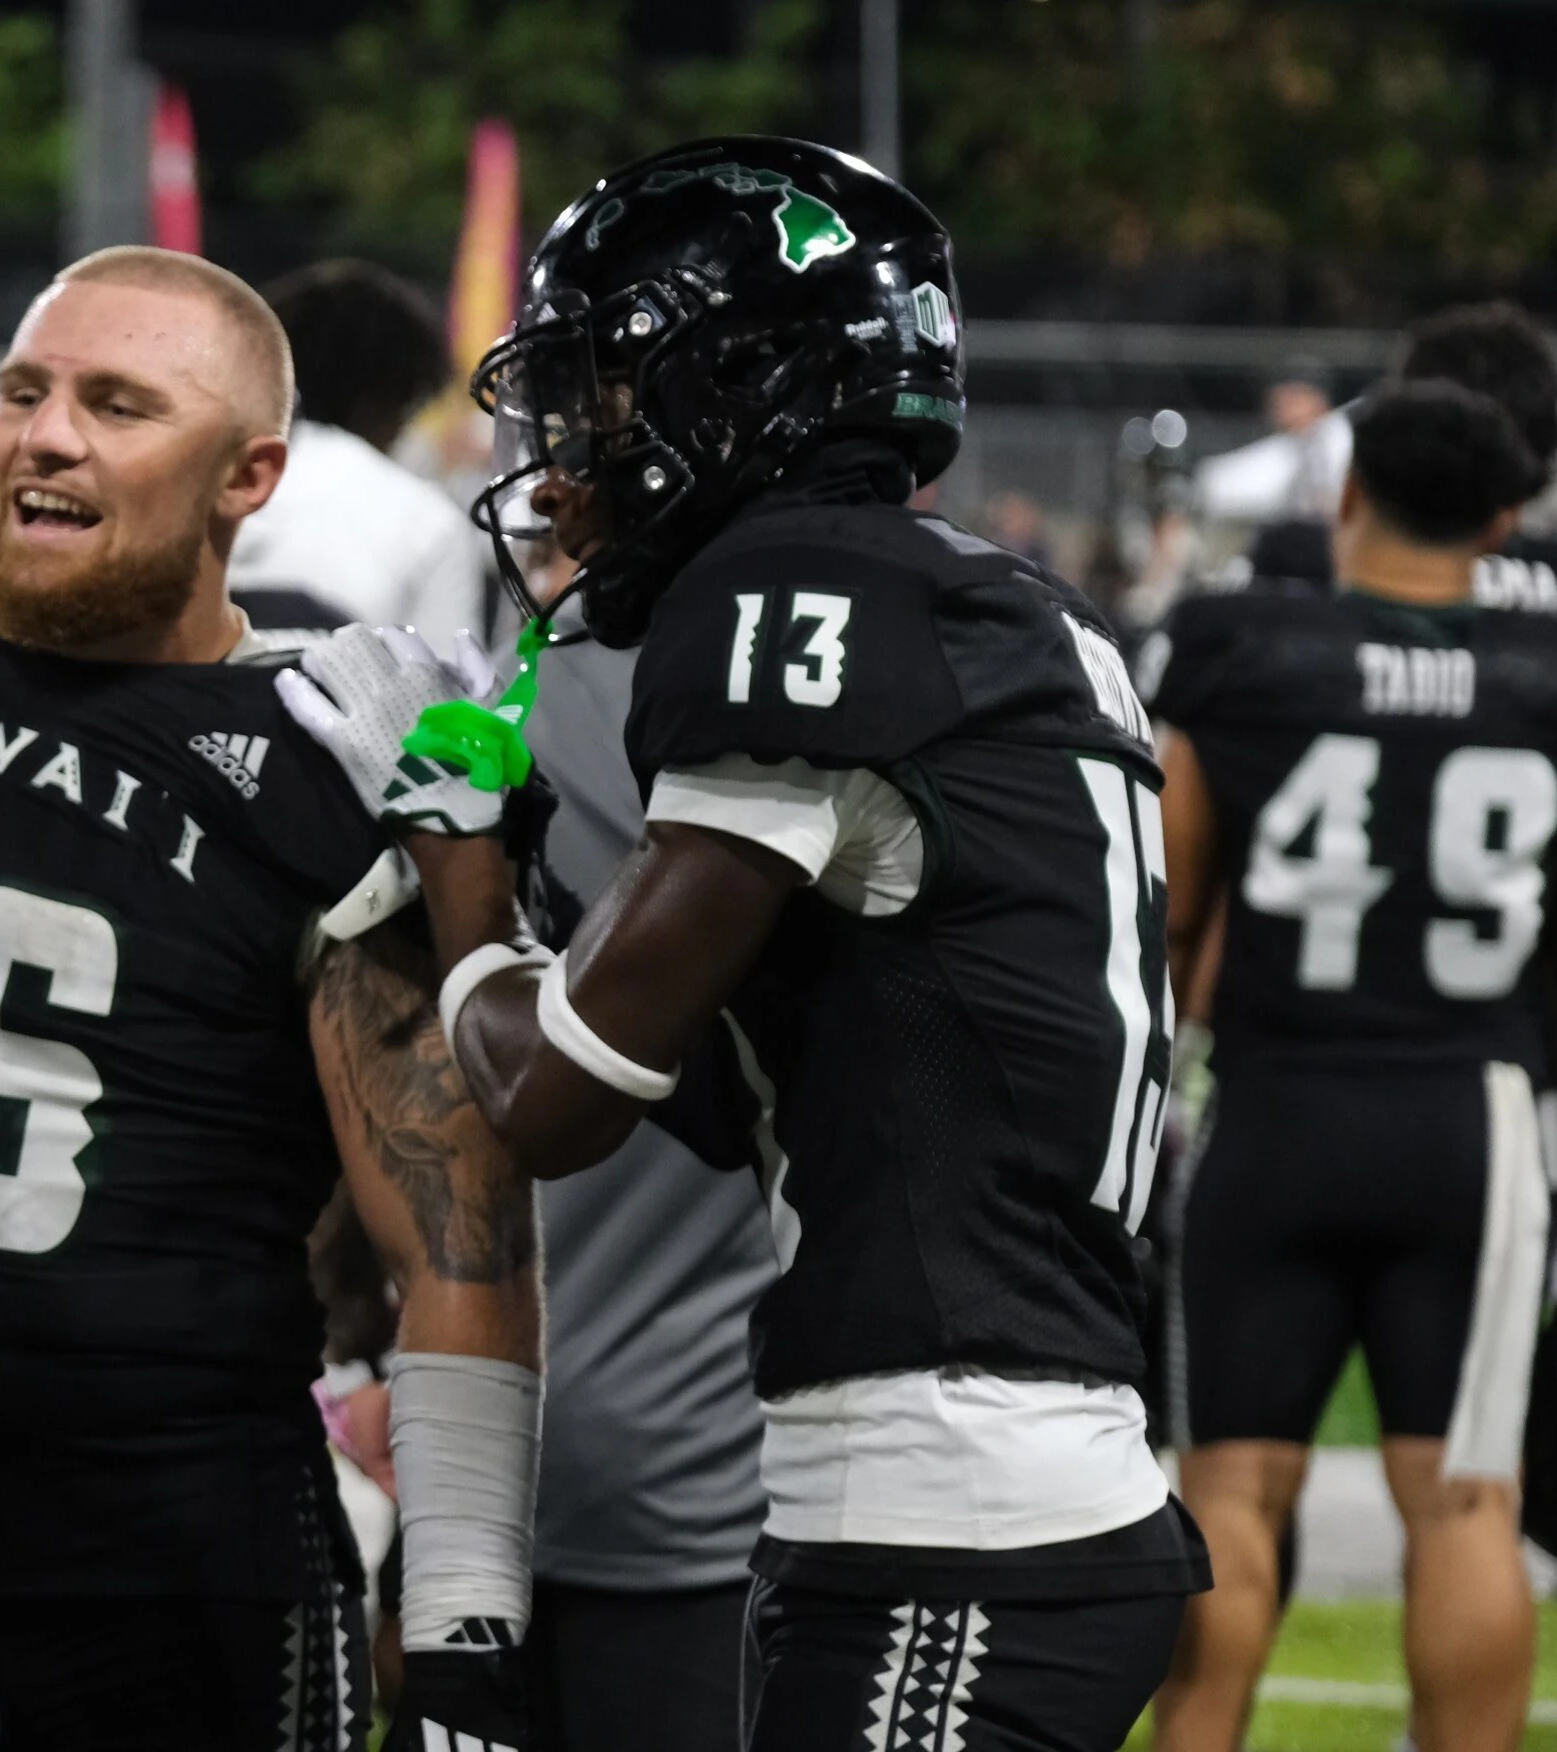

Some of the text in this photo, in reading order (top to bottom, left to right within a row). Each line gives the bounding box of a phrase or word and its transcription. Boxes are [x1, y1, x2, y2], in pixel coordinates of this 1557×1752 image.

[727, 593, 851, 708] 13
[188, 733, 261, 799] adidas
[1245, 733, 1557, 998] 49
